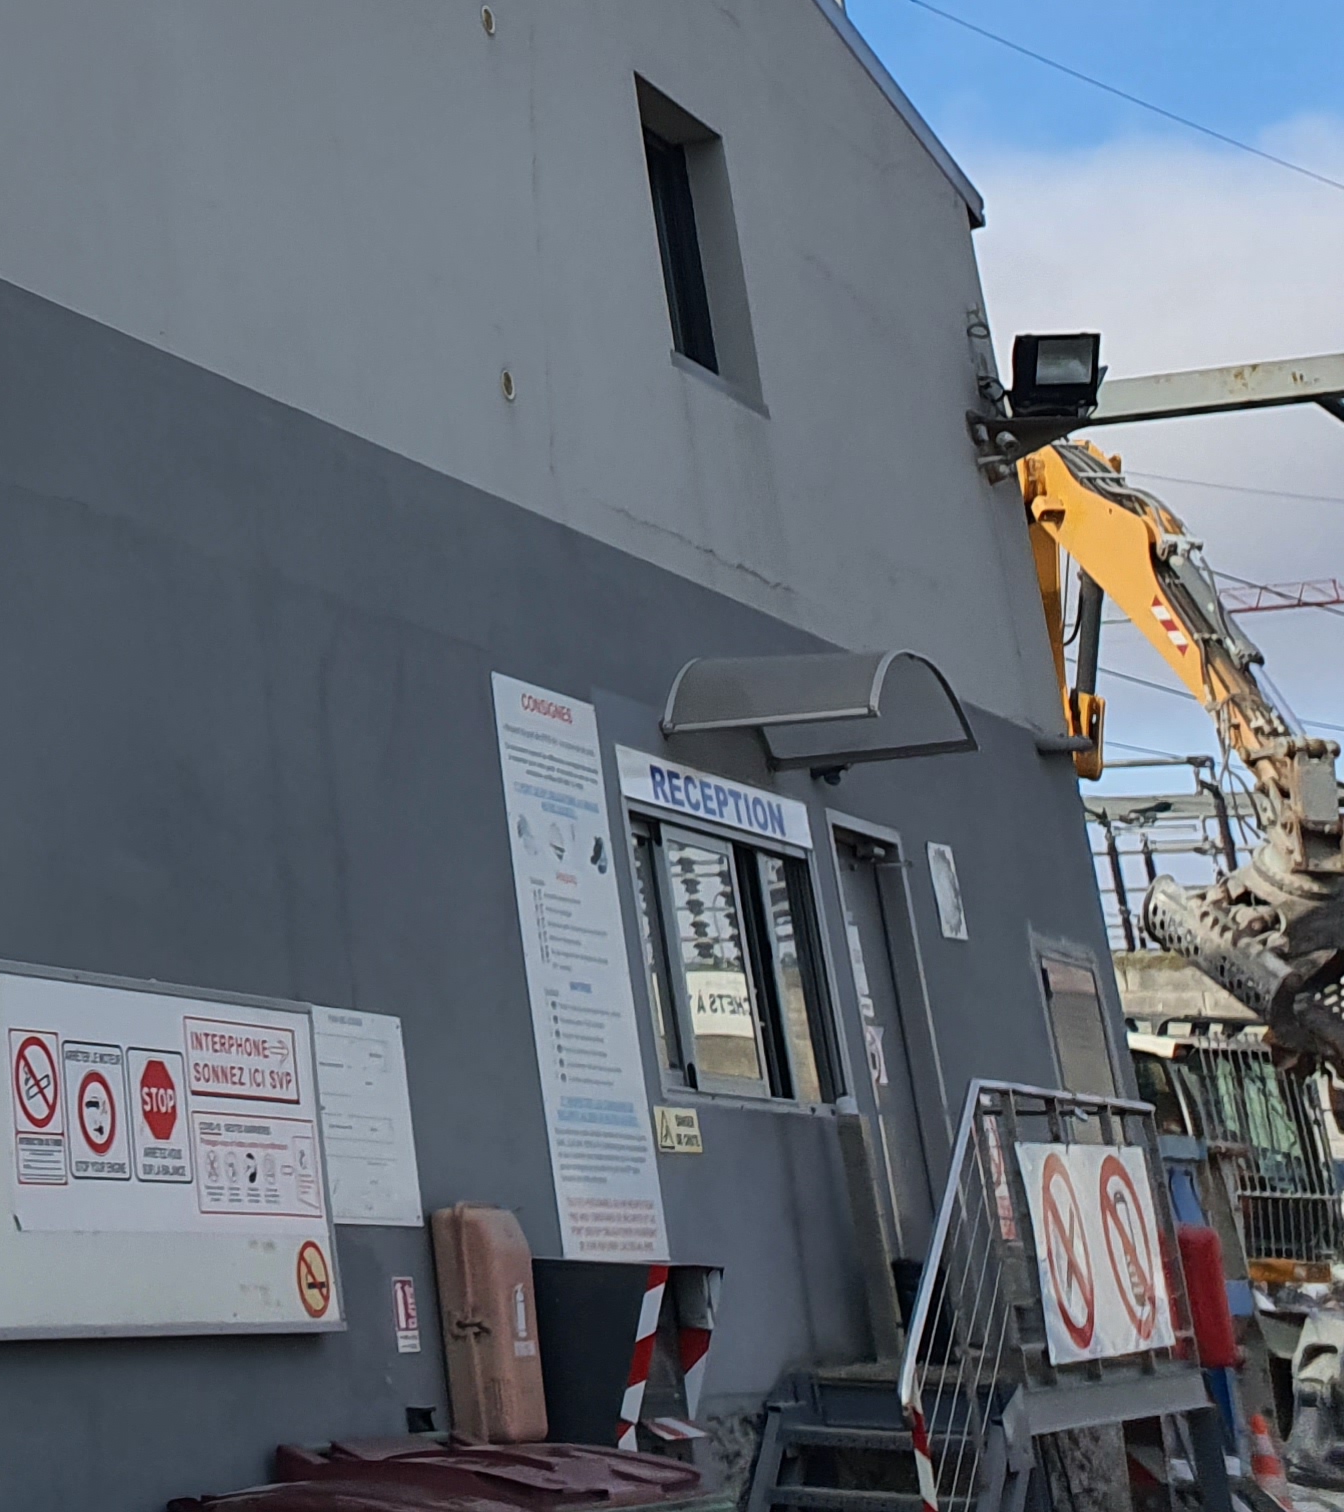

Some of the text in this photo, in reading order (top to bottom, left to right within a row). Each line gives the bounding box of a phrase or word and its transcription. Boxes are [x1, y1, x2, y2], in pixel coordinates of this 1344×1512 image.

[650, 763, 787, 838] RECEPTION
[190, 1031, 270, 1059] INTERPHONE
[193, 1062, 292, 1092] SONNEZ ICI SVP
[142, 1087, 176, 1113] STOP
